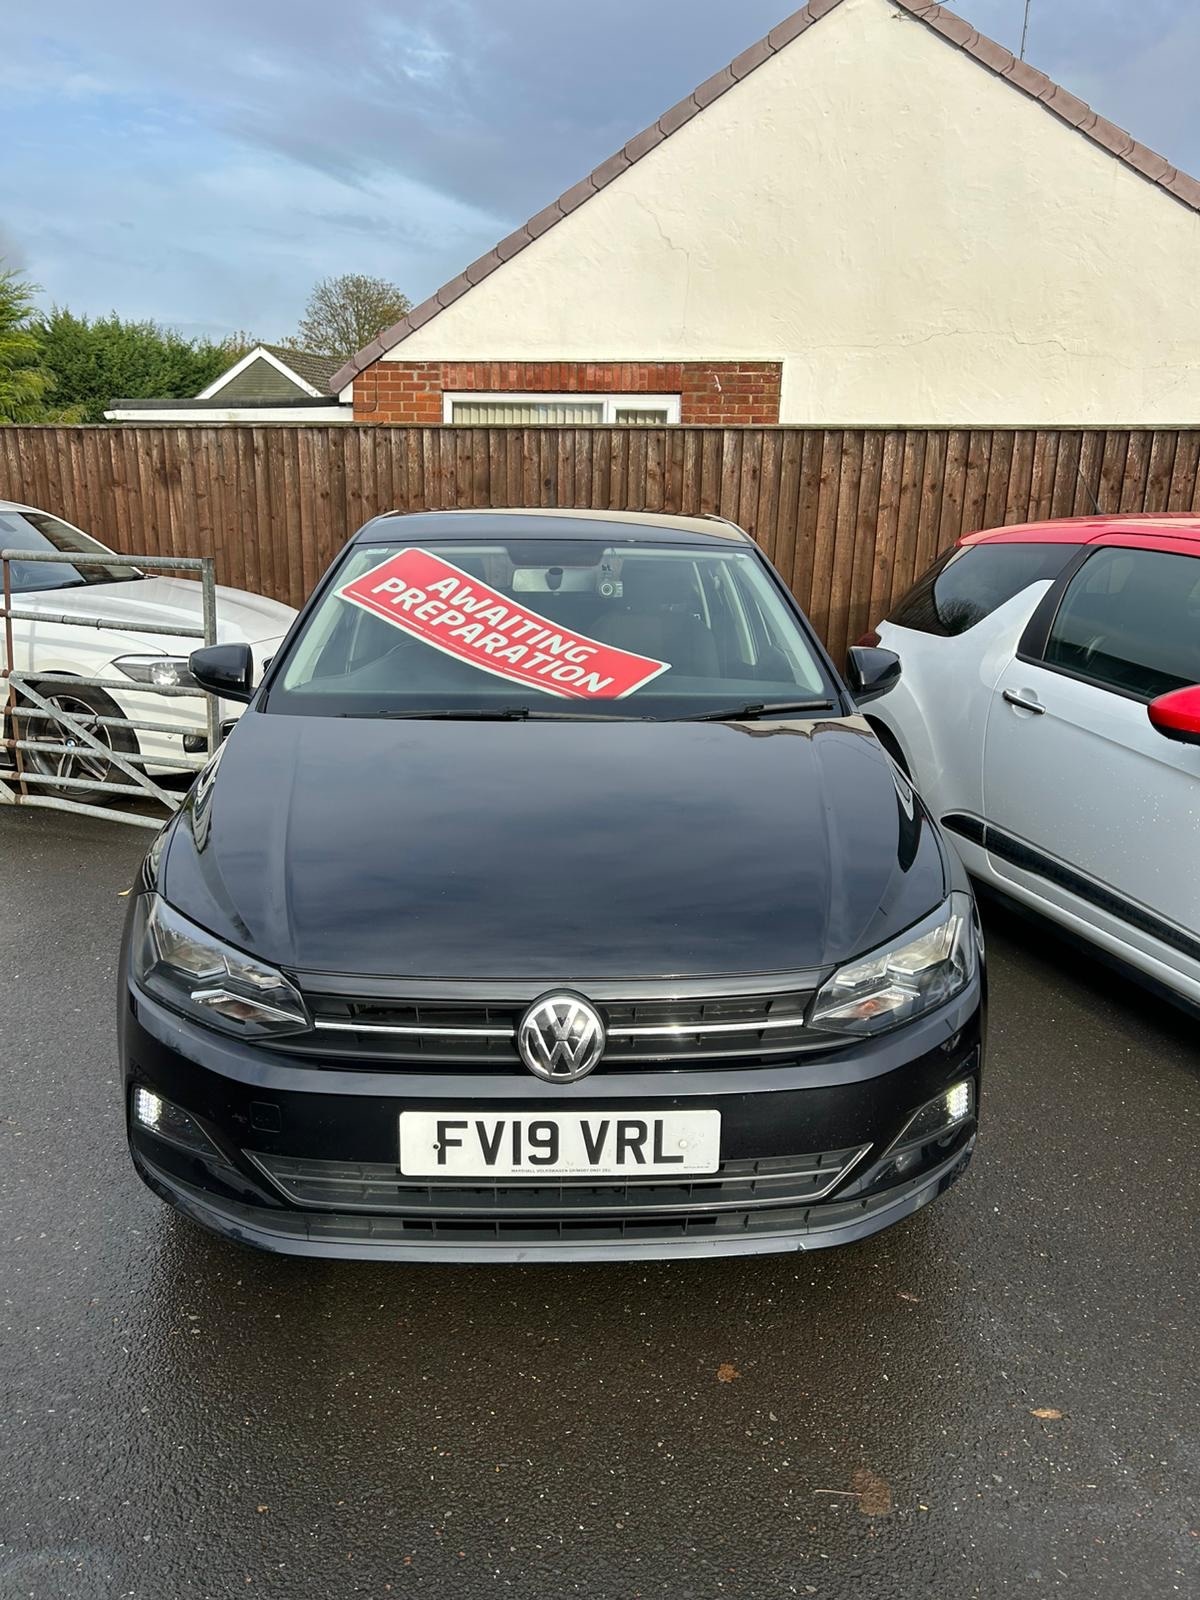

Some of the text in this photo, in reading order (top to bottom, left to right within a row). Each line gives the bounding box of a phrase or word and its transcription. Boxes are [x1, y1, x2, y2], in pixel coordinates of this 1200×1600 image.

[371, 577, 614, 693] PREPARATION
[426, 576, 599, 663] AWAITING
[437, 1119, 684, 1165] FV19 VRL
